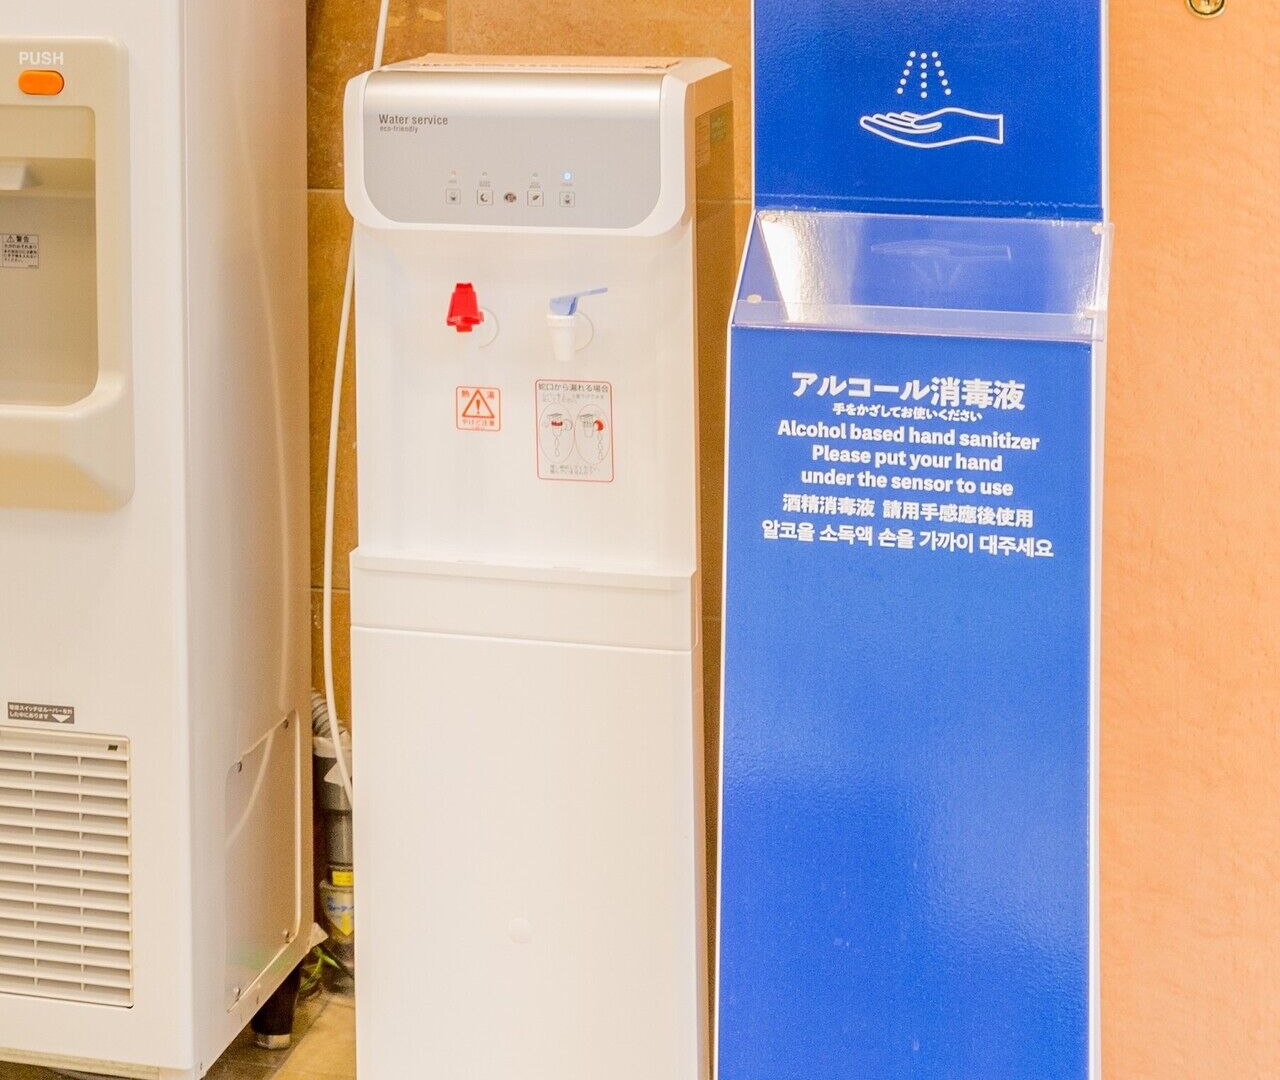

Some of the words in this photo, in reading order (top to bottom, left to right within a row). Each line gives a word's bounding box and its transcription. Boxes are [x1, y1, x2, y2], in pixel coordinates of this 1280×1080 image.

[19, 52, 65, 65] PUSH
[378, 114, 409, 125] Water
[411, 115, 449, 126] service
[792, 371, 1026, 411] アルコール消毒液
[832, 402, 983, 422] 手をかざしてお使いください
[778, 419, 846, 439] Alcohol
[850, 423, 905, 443] based
[909, 427, 955, 446] hand
[959, 430, 1040, 451] sanitizer
[812, 444, 871, 464] Please
[875, 450, 905, 469] put
[910, 454, 951, 471] your
[956, 452, 1002, 472] hand
[801, 468, 854, 486] under
[858, 471, 887, 488] the
[891, 476, 952, 493] sensor
[956, 477, 976, 494] to
[980, 480, 1014, 496] use
[782, 494, 875, 518] 酒精消毒液
[882, 499, 1033, 529] 請用手感應後使用
[762, 519, 815, 542] 알코올
[819, 524, 873, 546] 소독액
[878, 527, 915, 550] 손을
[919, 530, 974, 554] 가까이
[979, 534, 1054, 558] 대주세요
